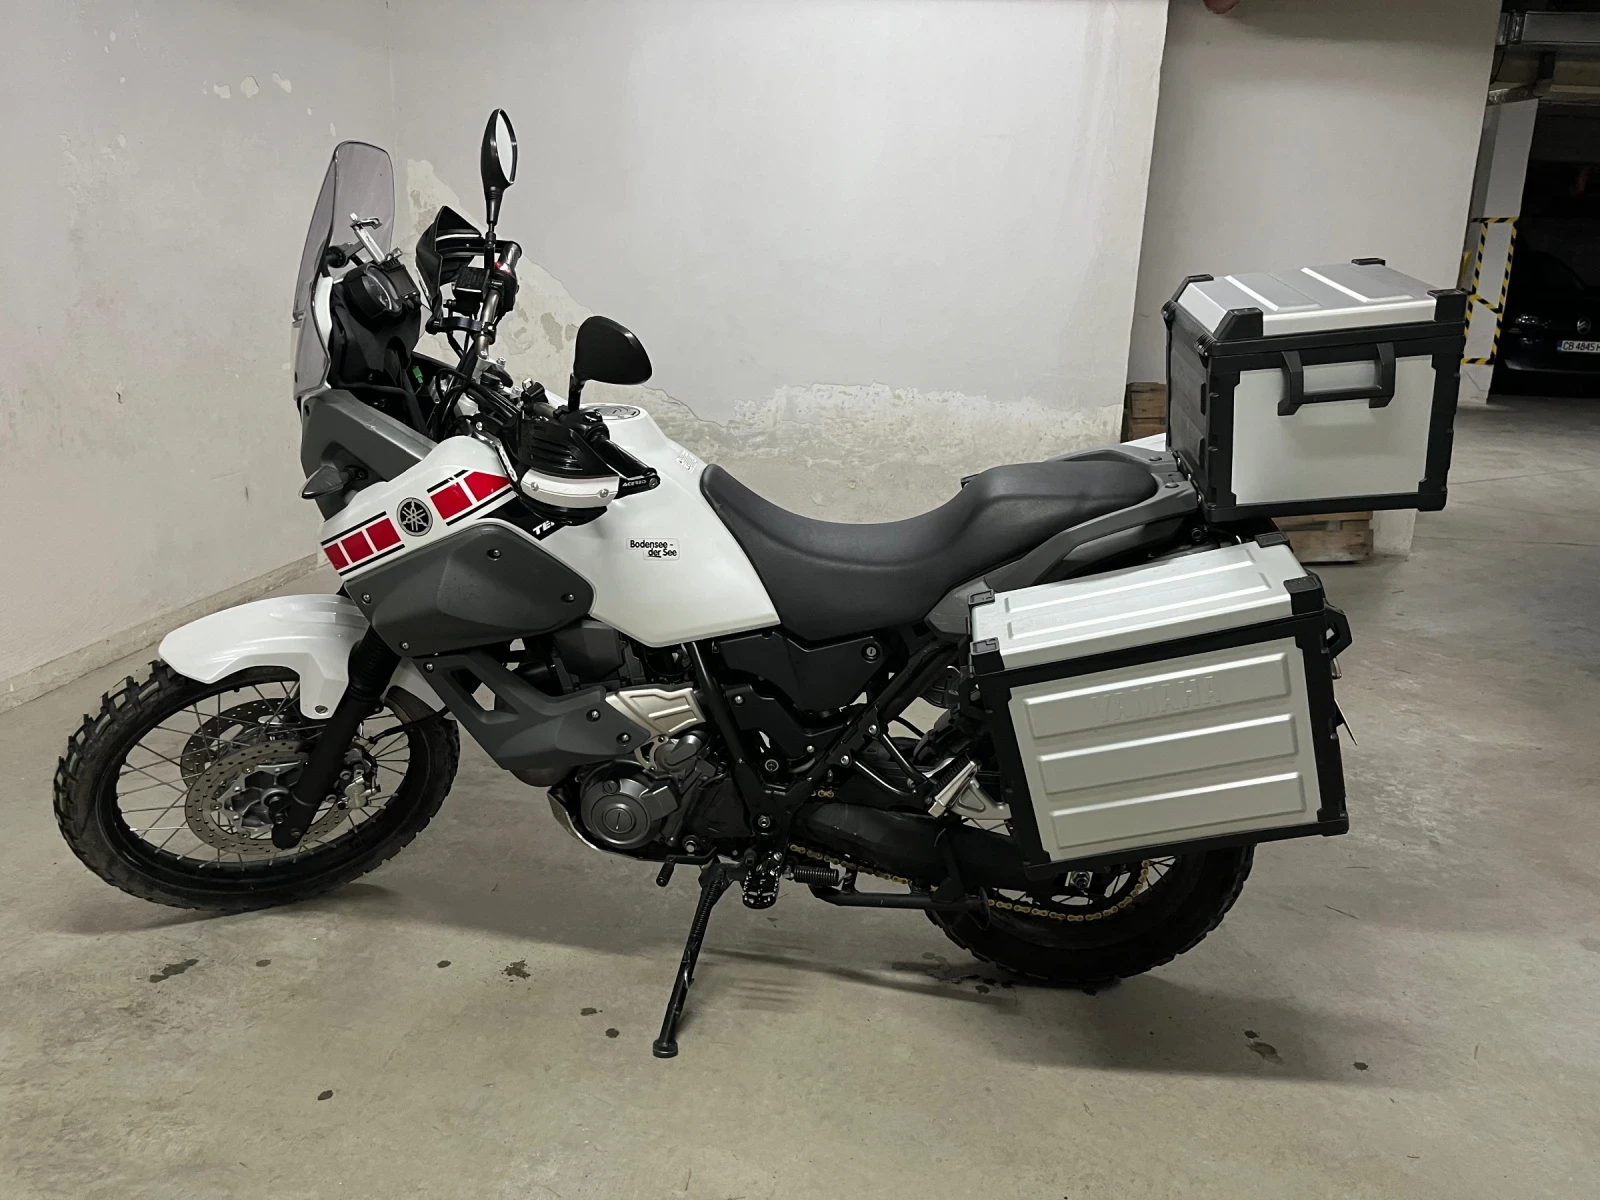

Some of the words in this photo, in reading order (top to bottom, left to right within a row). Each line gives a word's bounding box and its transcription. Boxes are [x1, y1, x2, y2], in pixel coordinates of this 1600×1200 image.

[1563, 341, 1574, 350] CB
[1575, 342, 1595, 351] 4845
[630, 539, 668, 548] Bodensee
[648, 548, 661, 557] der
[663, 548, 677, 556] See
[1090, 675, 1222, 722] YAMAHA
